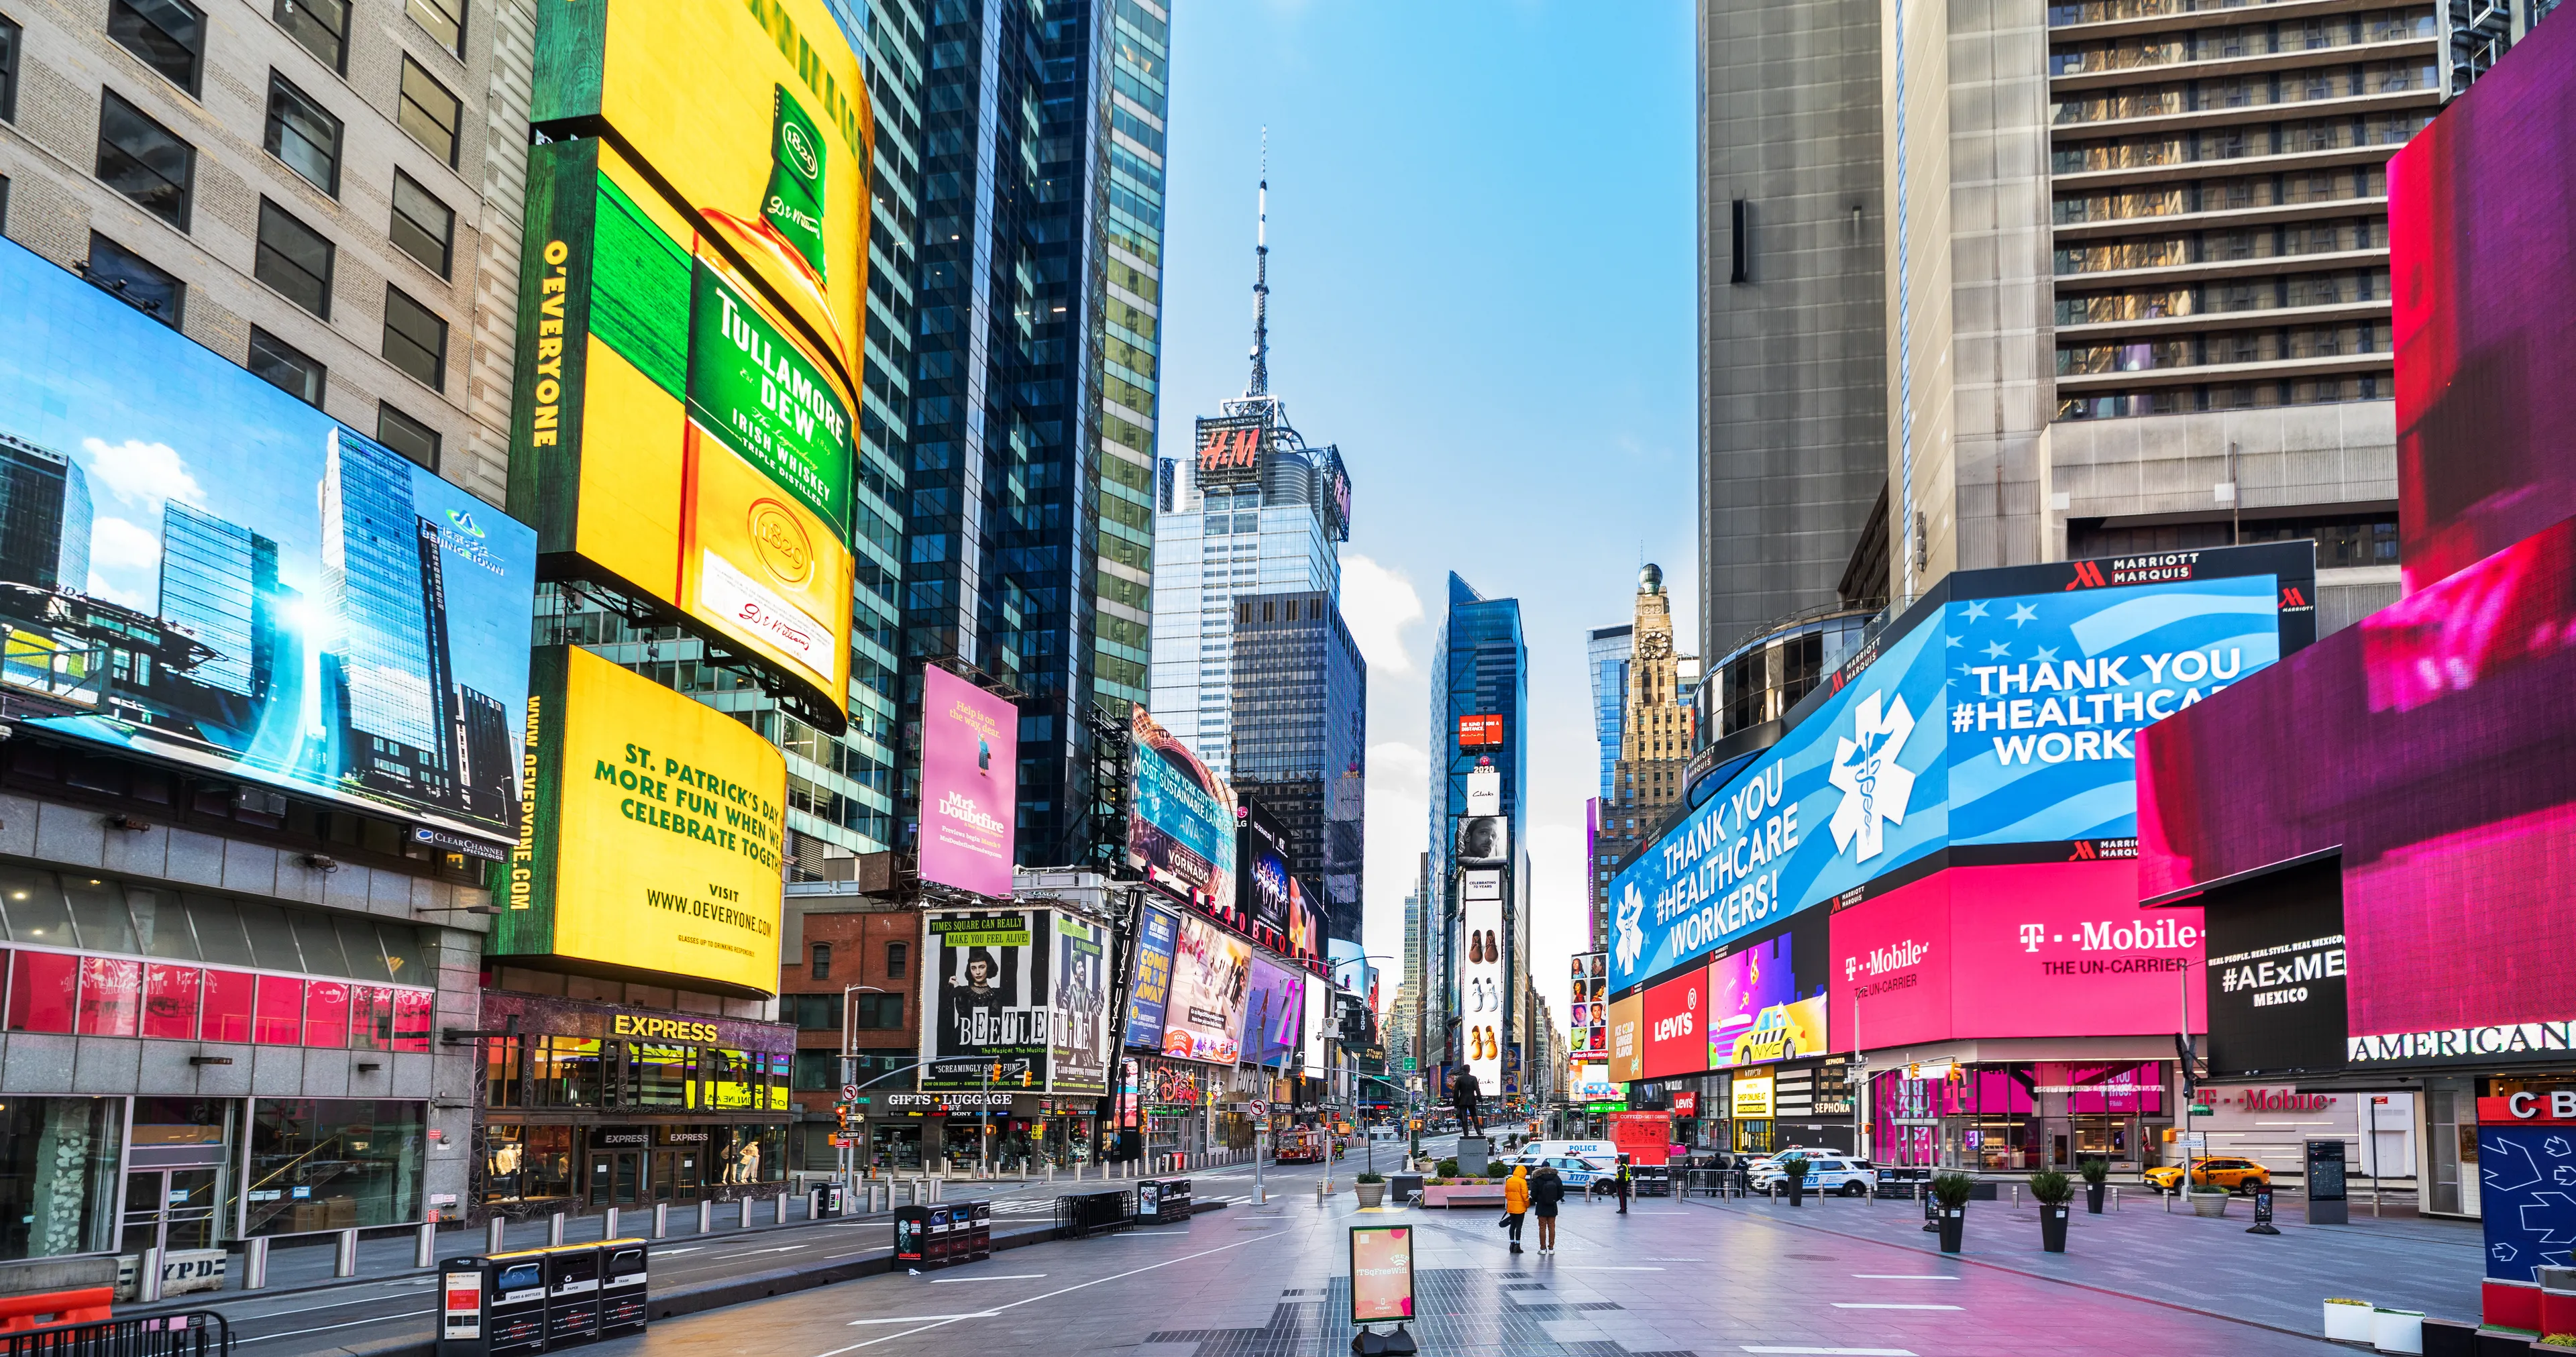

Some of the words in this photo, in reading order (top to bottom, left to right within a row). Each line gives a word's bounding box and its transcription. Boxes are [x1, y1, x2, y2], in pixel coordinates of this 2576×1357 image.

[787, 129, 816, 172] 1829
[533, 240, 568, 447] O'EVERYONE
[715, 287, 844, 447] TULLAMORE
[751, 406, 772, 429] The
[771, 427, 820, 470] Legendary
[1199, 428, 1260, 471] H&M
[732, 408, 771, 452] IRISH
[776, 442, 830, 502] WHISKEY
[742, 439, 776, 470] TRIPLE
[779, 466, 822, 507] DISTILLED
[761, 519, 804, 569] 1829
[2114, 553, 2199, 570] MARRIOTT
[2114, 566, 2190, 583] MARQUIS
[2282, 605, 2314, 613] MARRIOTT
[1846, 636, 1882, 669] MARRIOTT
[1846, 651, 1878, 682] MARQUIS
[1972, 655, 2131, 697] THANK
[2141, 648, 2241, 685] YOU
[955, 700, 976, 718] Help
[977, 708, 984, 722] is
[984, 714, 996, 726] on
[1952, 686, 2228, 733] #HEALTHCA
[949, 708, 963, 722] the
[964, 715, 981, 732] way,
[981, 721, 1002, 739] dear.
[1473, 765, 1495, 773] 2020
[1688, 745, 1715, 770] MARRIOTT
[1688, 757, 1711, 779] MARQUIS
[625, 743, 655, 772] ST.
[665, 758, 759, 813] PATRICK'S
[763, 799, 779, 824] DAY
[1132, 751, 1160, 783] MOST
[1159, 773, 1205, 820] SUSTAINABLE
[1166, 764, 1180, 780] NEW
[1179, 771, 1196, 796] YORK
[1196, 788, 1213, 810] CITY'S
[594, 759, 667, 803] MORE
[676, 788, 718, 820] FUN
[725, 805, 765, 839] WHEN
[768, 829, 780, 851] WE
[949, 791, 976, 809] Mrs.
[621, 798, 737, 852] CELEBRATE
[938, 798, 1004, 834] Doubtfire
[1236, 820, 1247, 828] LG
[1662, 811, 1725, 871] THANK
[1731, 757, 1784, 826] YOU
[940, 834, 1002, 859] MrsDoubtfireBroadway.com
[942, 825, 965, 838] Previews
[966, 833, 980, 843] begin
[981, 838, 998, 848] March
[463, 847, 504, 861] SPECTACOLOR
[1656, 800, 1799, 926] #HEALTHCARE
[1168, 849, 1209, 883] VORNADO
[709, 883, 739, 902] VISIT
[1032, 890, 1061, 898] LAMAR
[1841, 886, 1865, 901] MARRIOTT
[1842, 895, 1862, 908] MARQUIS
[646, 889, 771, 938] WWW.OEVERYONE.COM
[1191, 888, 1246, 932] 1540
[1670, 868, 1778, 959] WORKERS!
[931, 921, 952, 931] TIMES
[953, 920, 979, 930] SQUARE
[981, 919, 996, 929] CAN
[997, 918, 1023, 928] REALLY
[678, 934, 699, 945] GLASSES
[700, 938, 706, 946] UP
[708, 940, 714, 948] TO
[714, 940, 733, 953] DRINKING
[948, 933, 969, 944] MAKE
[971, 933, 985, 944] YOU
[986, 933, 1004, 944] FEEL
[1006, 933, 1028, 943] ALIVE!
[1142, 942, 1151, 951] COME
[1151, 944, 1166, 955] TOGETHER
[1715, 944, 1729, 955] MARRIOTT
[1140, 948, 1169, 971] COME
[1715, 950, 1727, 959] MARQUIS
[2208, 957, 2224, 966] REAL
[2251, 949, 2268, 959] REAL
[2292, 940, 2312, 953] REAL
[2043, 961, 2076, 975] THE
[2080, 957, 2188, 975] UN-CARRIER
[2222, 949, 2347, 992] #AExME
[1135, 982, 1166, 1004] AWAY
[1854, 984, 1868, 999] THE
[1869, 974, 1917, 997] UN-CARRIER
[2253, 987, 2308, 1008] MEXICO
[1280, 978, 1304, 1048] 21
[614, 1014, 718, 1043] EXPRESS
[959, 1005, 1048, 1046] BEETLE
[1622, 1020, 1634, 1034] COLD
[993, 1046, 1014, 1054] Musical.
[1026, 1046, 1046, 1054] Musical.
[1615, 1046, 1633, 1059] FLAVOR
[1616, 1035, 1633, 1048] GINGER
[1753, 1040, 1781, 1059] NYC
[2354, 1022, 2573, 1062] AMERICAN
[1589, 1051, 1609, 1059] Monday
[1825, 1057, 1845, 1065] SEPHORA
[888, 1094, 930, 1105] GIFTS
[943, 1094, 1012, 1105] LUGGAGE
[1815, 1103, 1850, 1114] SEPHORA
[606, 1135, 649, 1143] EXPRESS
[671, 1133, 708, 1141] EXPRESS
[1568, 1174, 1590, 1182] NYPD
[1390, 1254, 1409, 1262] FREE
[1356, 1266, 1407, 1277] !TSqFreeWifi
